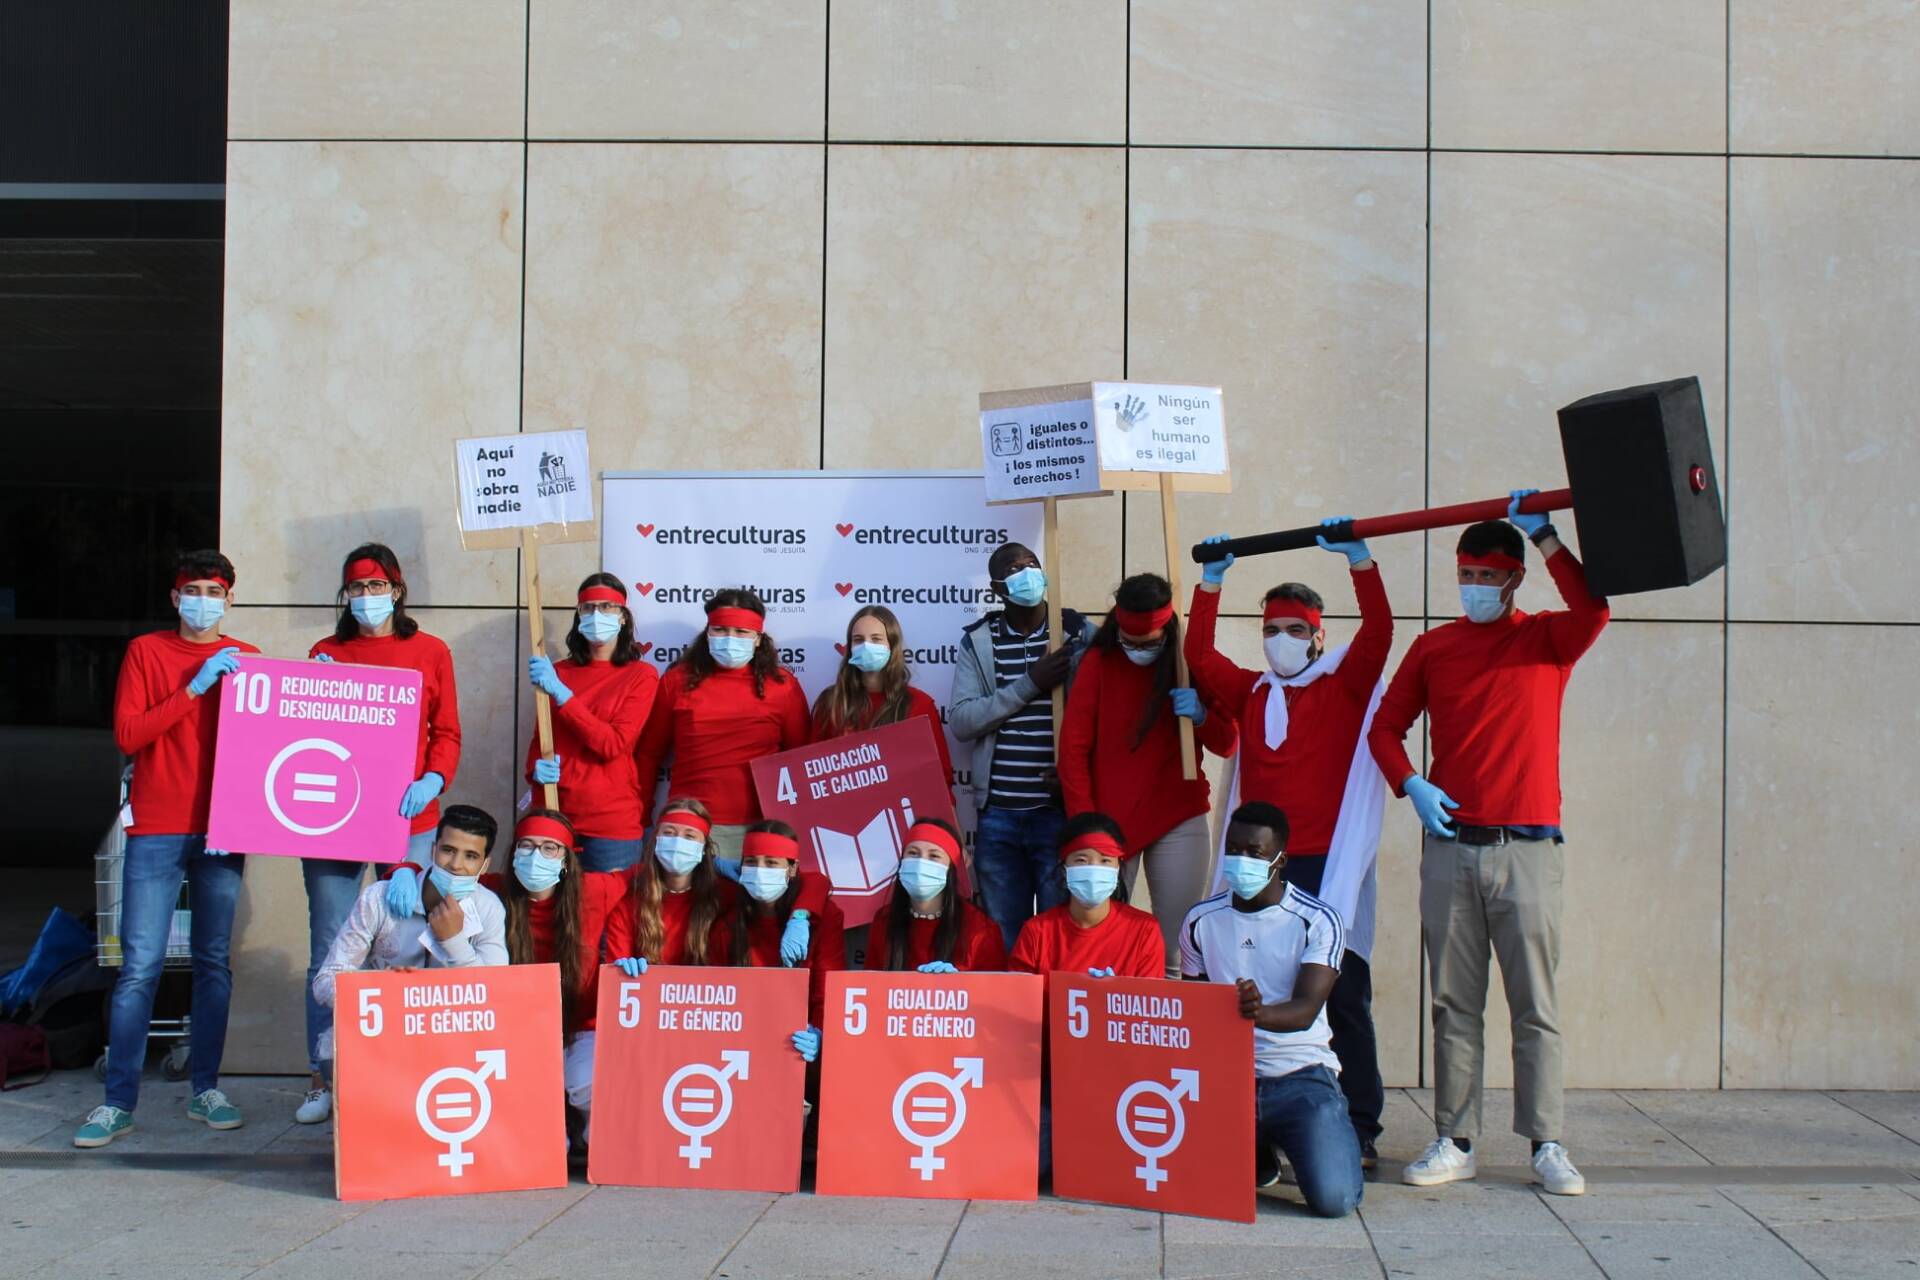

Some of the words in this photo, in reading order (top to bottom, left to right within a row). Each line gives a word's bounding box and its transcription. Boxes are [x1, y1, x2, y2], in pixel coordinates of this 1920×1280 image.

[1158, 395, 1211, 410] Ningún
[1030, 421, 1077, 436] iguales
[1080, 421, 1088, 430] o
[1173, 415, 1196, 426] ser
[1026, 437, 1095, 450] distintos...
[1152, 429, 1210, 444] humano
[477, 445, 514, 462] Aquí
[1013, 459, 1032, 470] los
[1036, 454, 1085, 468] mismos
[1136, 449, 1152, 459] es
[1158, 447, 1196, 463] ilegal
[487, 467, 506, 478] no
[1013, 471, 1072, 485] derechos
[538, 480, 576, 498] NADIE
[478, 500, 521, 515] nadie
[655, 526, 806, 544] entreculturas
[855, 525, 1008, 544] entreculturas
[232, 672, 271, 714] 10
[280, 676, 363, 700] REDUCCIÓN
[367, 684, 385, 702] DE
[389, 685, 416, 705] LAS
[279, 699, 396, 726] DESIGUALDADES
[804, 744, 881, 778] EDUCACIÓN
[777, 767, 797, 805] 4
[810, 779, 830, 800] DE
[831, 765, 888, 794] CALIDAD
[404, 983, 487, 1008] IGUALDAD
[618, 982, 640, 1028] 5
[660, 983, 737, 1005] IGUALDAD
[888, 989, 968, 1011] IGUALDAD
[359, 988, 383, 1037] 5
[844, 987, 867, 1035] 5
[1068, 988, 1089, 1038] 5
[1107, 992, 1182, 1020] IGUALDAD
[405, 1014, 426, 1035] DE
[431, 1009, 495, 1034] GÉNERO
[658, 1009, 679, 1030] DE
[683, 1008, 743, 1032] GÉNERO
[887, 1016, 908, 1036] DE
[912, 1013, 976, 1038] GÉNERO
[1107, 1020, 1126, 1043] DE
[1131, 1020, 1190, 1049] GÉNERO
